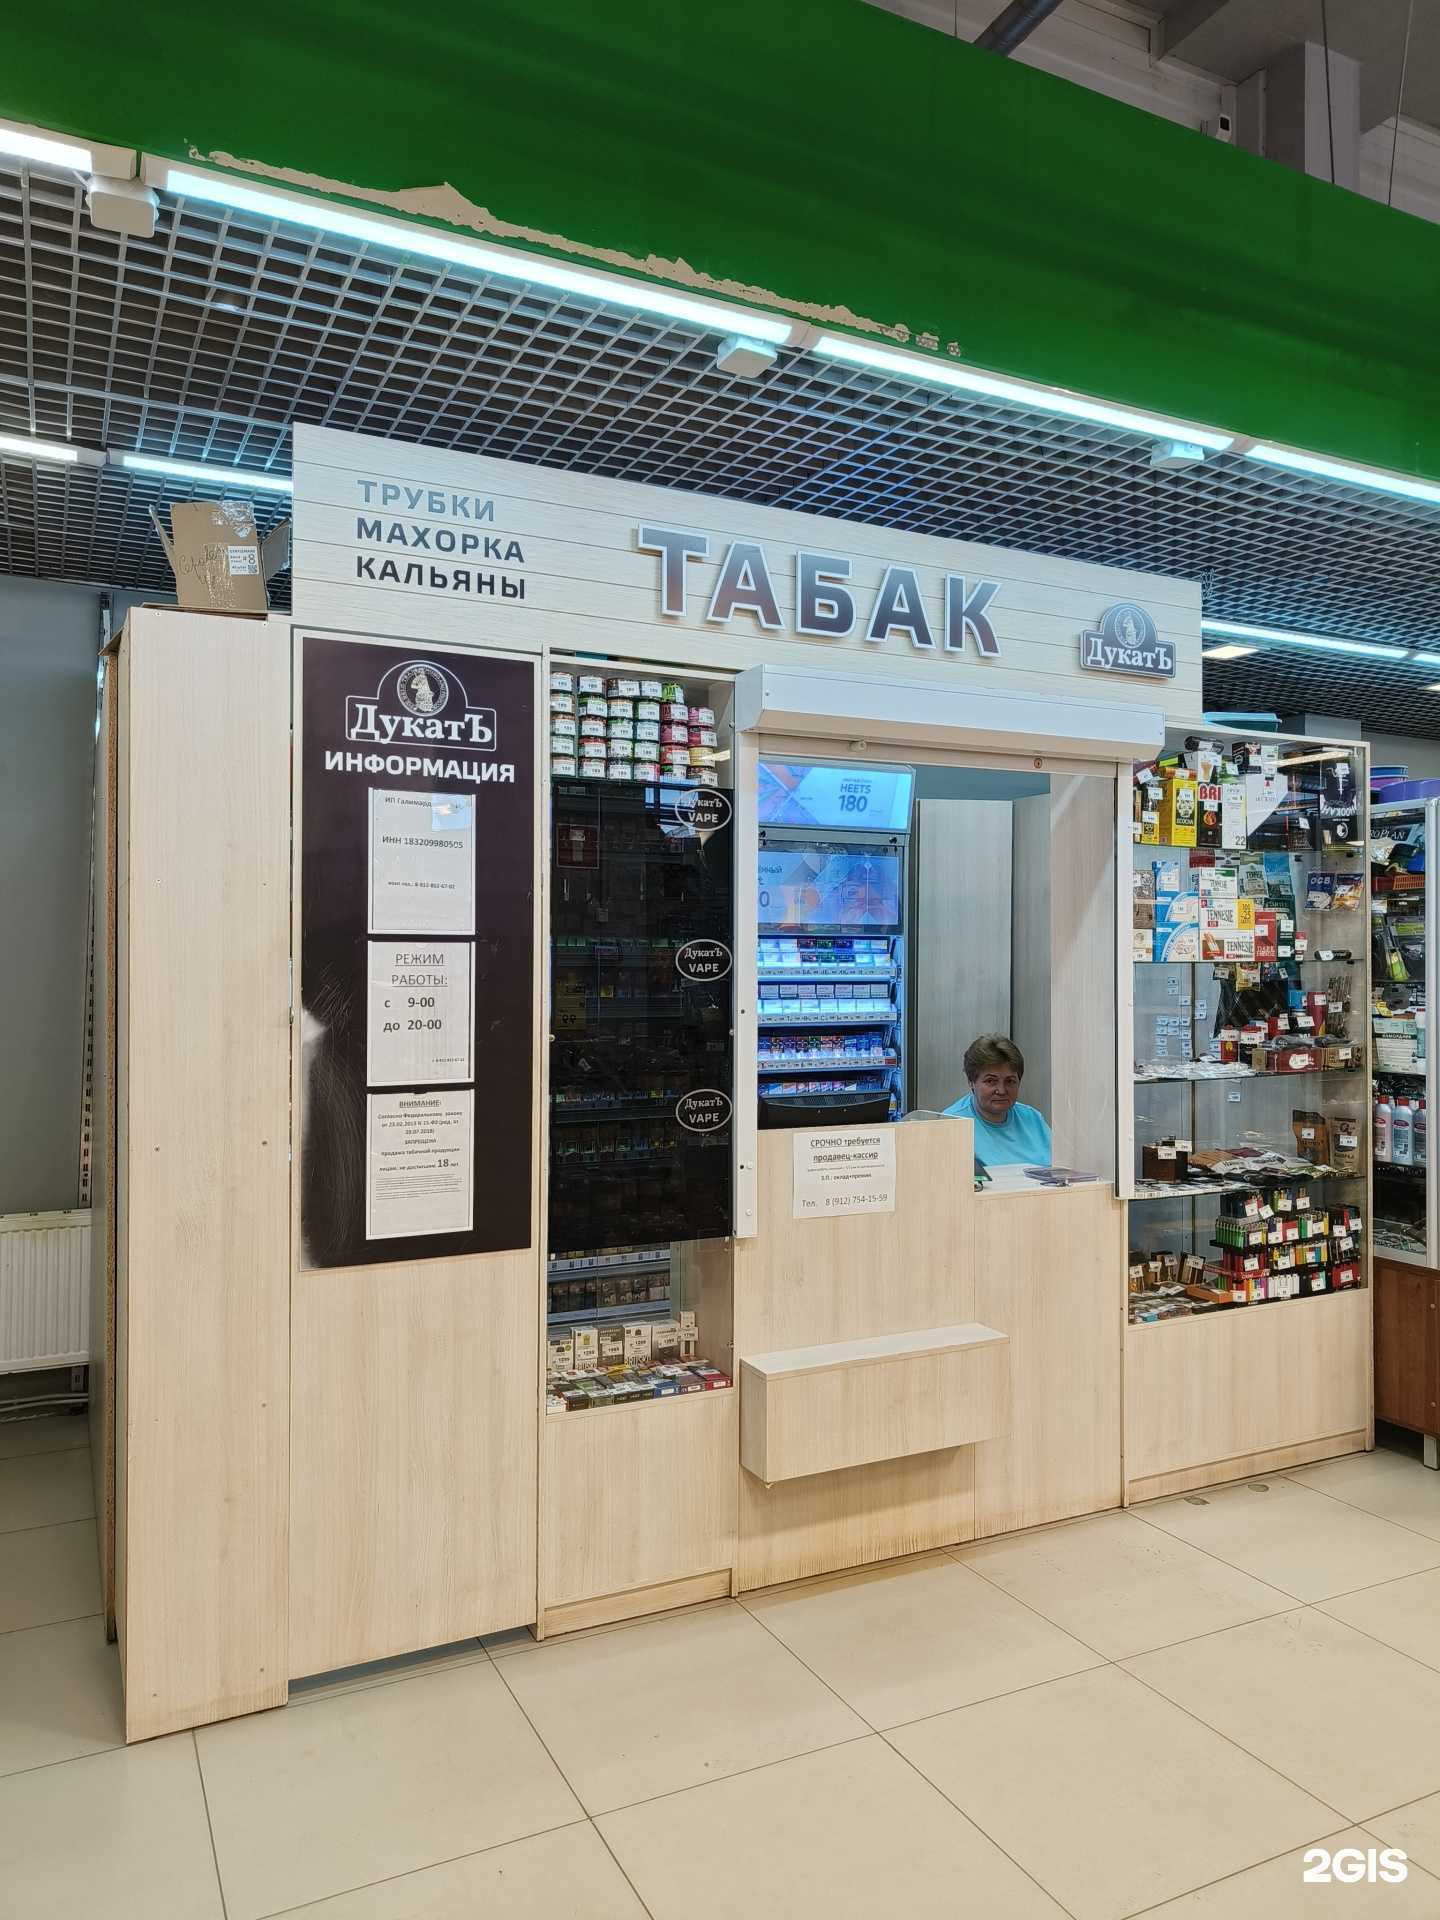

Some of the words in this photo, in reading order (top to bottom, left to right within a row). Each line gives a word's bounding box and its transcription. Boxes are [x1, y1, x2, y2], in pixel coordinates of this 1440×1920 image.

[357, 480, 495, 522] ТРУБКИ
[356, 517, 525, 563] МАХОРКА
[356, 555, 525, 600] КАЛЬЯНЫ
[637, 523, 1002, 658] ТАБАК
[1087, 637, 1172, 669] ДукатЪ
[350, 703, 493, 744] ДукатЪ
[325, 751, 515, 784] ИНФОРМАЦИЯ
[840, 783, 872, 794] HEETS
[838, 795, 868, 813] 180
[688, 813, 719, 823] VAPE
[382, 836, 402, 844] ИНН
[1235, 836, 1246, 846] 22
[1310, 877, 1331, 885] OCB
[395, 953, 444, 965] РЕЖИМ
[684, 947, 723, 960] ДукатЪ
[688, 963, 719, 973] VAPE
[391, 974, 448, 986] РАБОТЫ:
[407, 997, 435, 1008] 9-00
[383, 1022, 400, 1033] до
[407, 1019, 442, 1031] 20-00
[684, 1097, 723, 1110] ДукатЪ
[689, 1113, 720, 1123] VAPE
[810, 1138, 842, 1148] СРОЧНО
[844, 1136, 881, 1147] требуется
[813, 1151, 879, 1162] продавец-кассир
[437, 1158, 449, 1168] 18
[825, 1198, 831, 1206] 8
[832, 1196, 851, 1206] (912)
